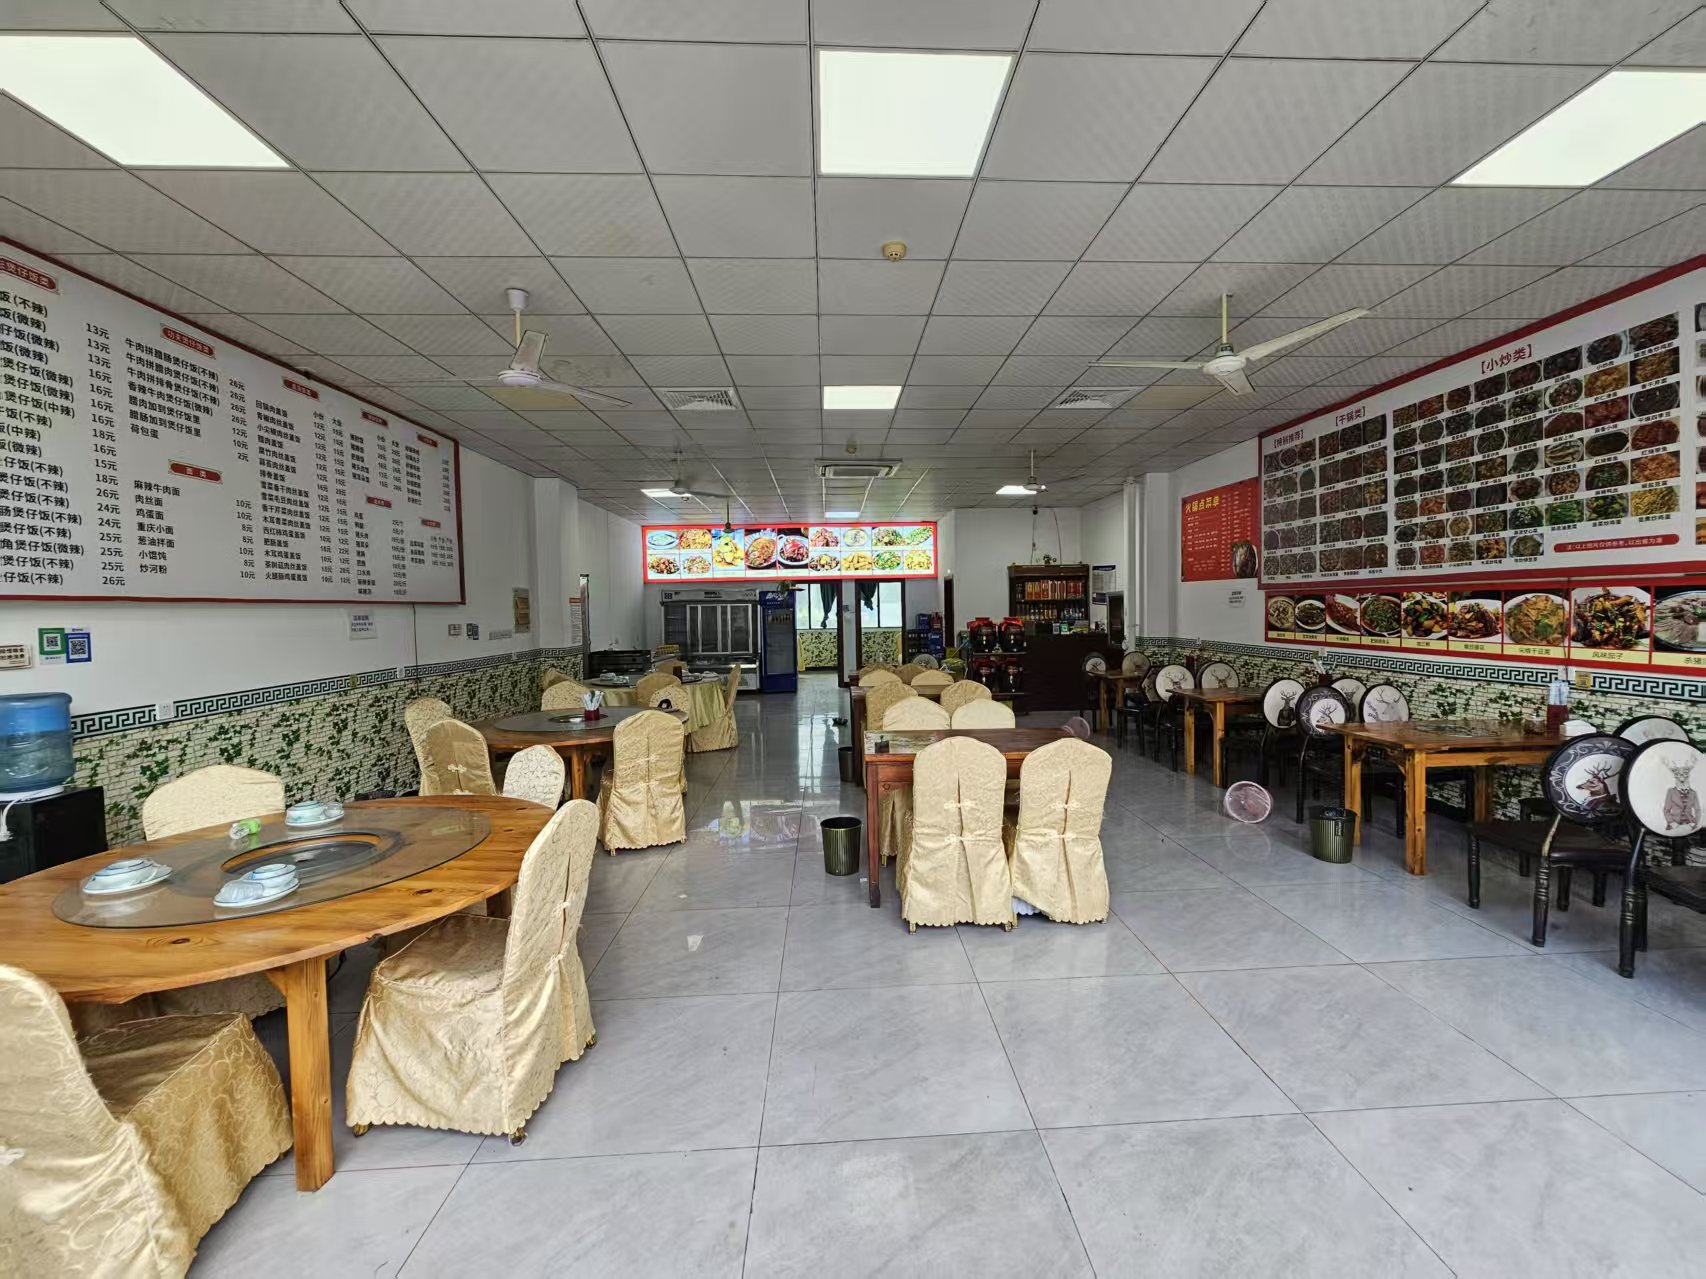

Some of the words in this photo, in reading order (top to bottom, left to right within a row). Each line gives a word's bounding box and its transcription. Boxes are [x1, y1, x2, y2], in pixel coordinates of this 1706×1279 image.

[87, 323, 110, 340] 13元
[88, 338, 111, 355] 13元
[88, 354, 111, 369] 13元
[0, 357, 73, 388] 煲仔饭(微辣)
[90, 383, 114, 398] 16元
[89, 368, 113, 384] 16元
[0, 374, 74, 403] 煲仔饭(微辣)
[91, 398, 114, 413] 16元
[0, 390, 75, 419] 煲仔饭(中辣)
[92, 413, 115, 428] 16元
[93, 428, 117, 443] 18元
[232, 427, 248, 438] 12元
[94, 443, 118, 457] 16元
[0, 456, 63, 478] 仔饭(不辣)
[96, 473, 119, 486] 18元
[95, 458, 119, 472] 15元
[97, 487, 121, 501] 26元
[134, 480, 180, 496] 麻辣牛肉面
[236, 499, 252, 509] 10元
[98, 502, 121, 515] 24元
[135, 494, 163, 507] 肉丝面
[237, 511, 252, 521] 10元
[1185, 496, 1220, 513] 火锅点菜单
[136, 508, 164, 521] 鸡蛋面
[98, 517, 122, 530] 24元
[99, 531, 123, 544] 25元
[137, 522, 174, 535] 重庆小面
[242, 535, 254, 544] 8元
[101, 546, 124, 558] 25元
[138, 535, 175, 549] 葱油拌面
[239, 547, 255, 557] 10元
[0, 555, 74, 571] 煲仔饭(不辣)
[102, 561, 125, 573] 25元
[139, 549, 167, 561] 小馄饨
[243, 559, 255, 568] 8元
[0, 571, 64, 586] 仔饭(不辣)
[103, 575, 126, 587] 26元
[140, 563, 167, 575] 炒河粉
[240, 571, 256, 580] 10元
[1592, 652, 1624, 660] 风味茄子
